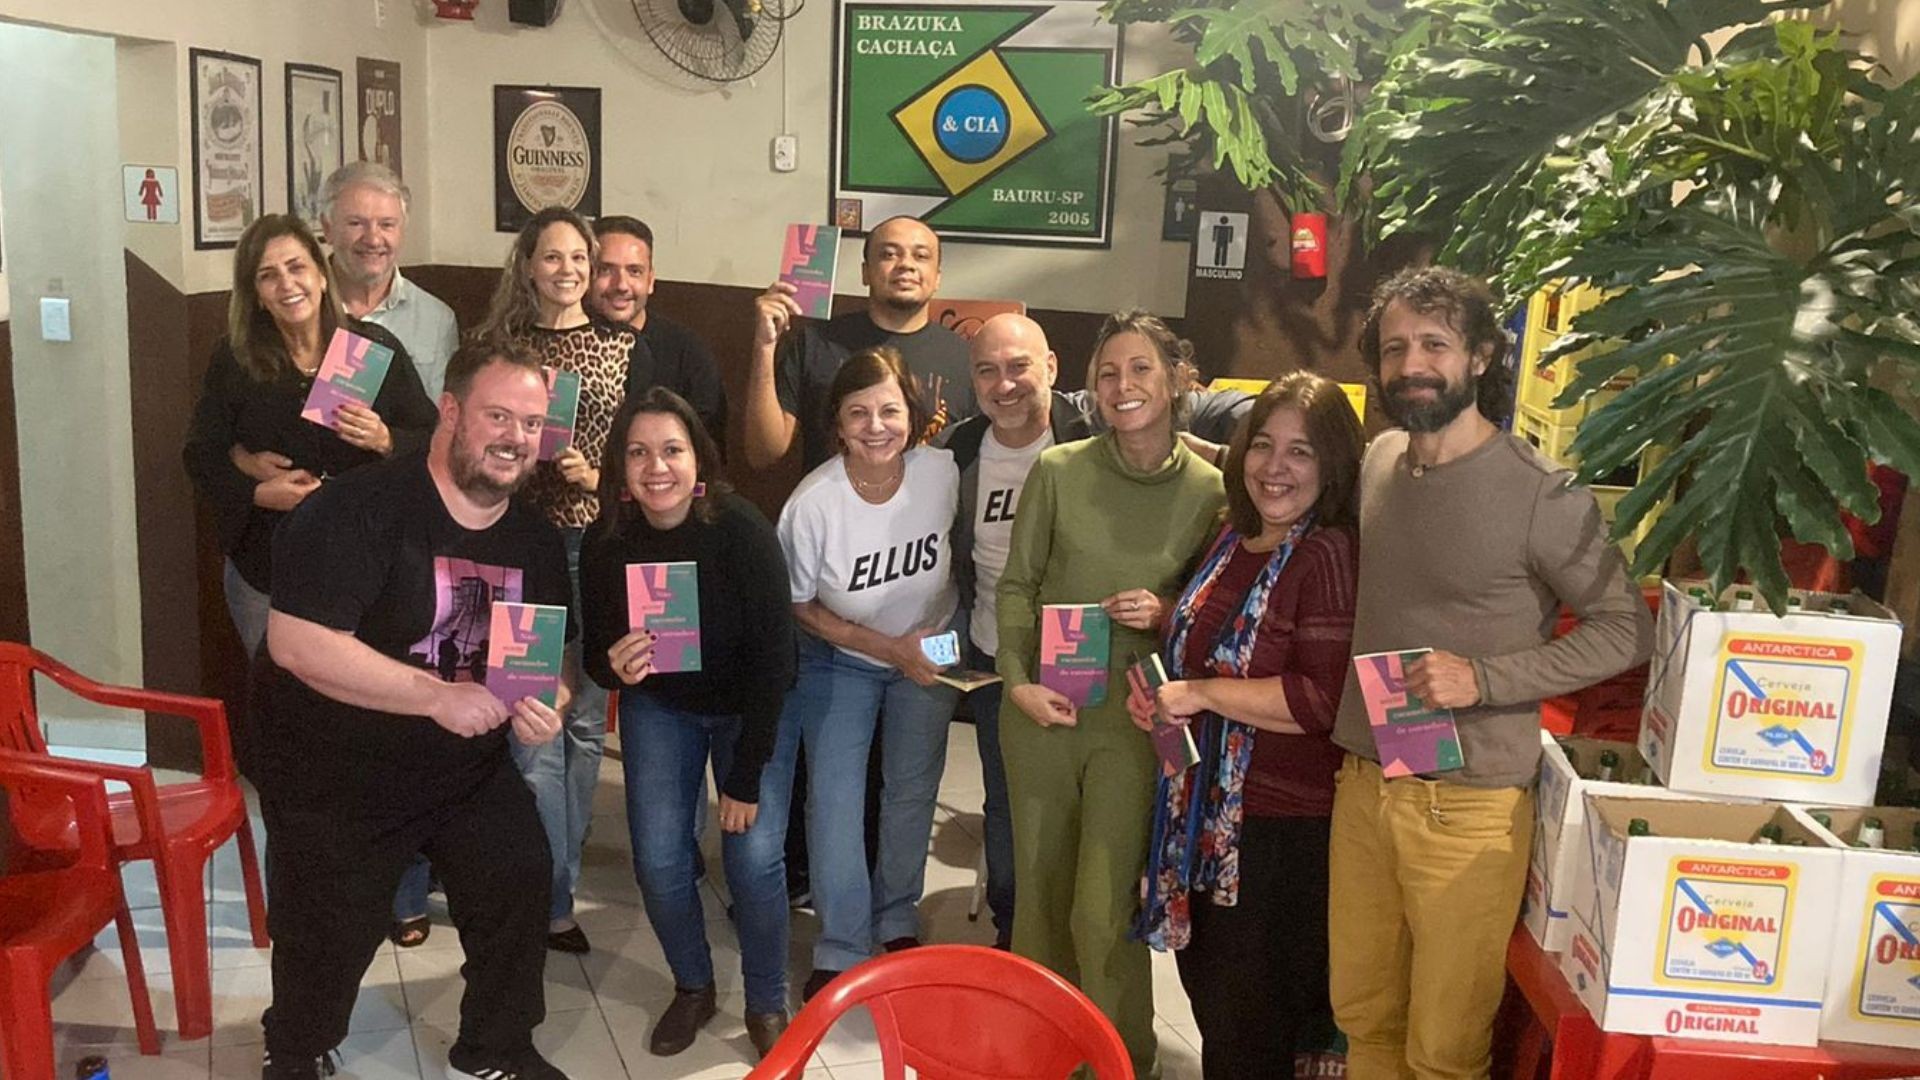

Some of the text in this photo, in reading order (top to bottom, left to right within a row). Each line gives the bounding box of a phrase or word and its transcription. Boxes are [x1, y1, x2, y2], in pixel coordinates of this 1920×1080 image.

[857, 15, 964, 32] BRAZUKA
[857, 39, 957, 59] CACHAÇA
[942, 115, 1000, 133] & CIA
[513, 145, 585, 168] GUINNESS
[992, 189, 1084, 206] BAURU-SP
[1048, 212, 1091, 226] 2005
[1195, 268, 1243, 280] MASCULINO
[847, 533, 939, 593] ELLUS
[1742, 641, 1838, 658] ANTARCTICA
[1757, 676, 1812, 692] Cerveja
[1727, 690, 1838, 720] ORIGINAL
[1691, 863, 1777, 878] ANTARCTICA
[1677, 906, 1778, 934] ORIGINAL
[1665, 1009, 1760, 1034] ORIGINAL
